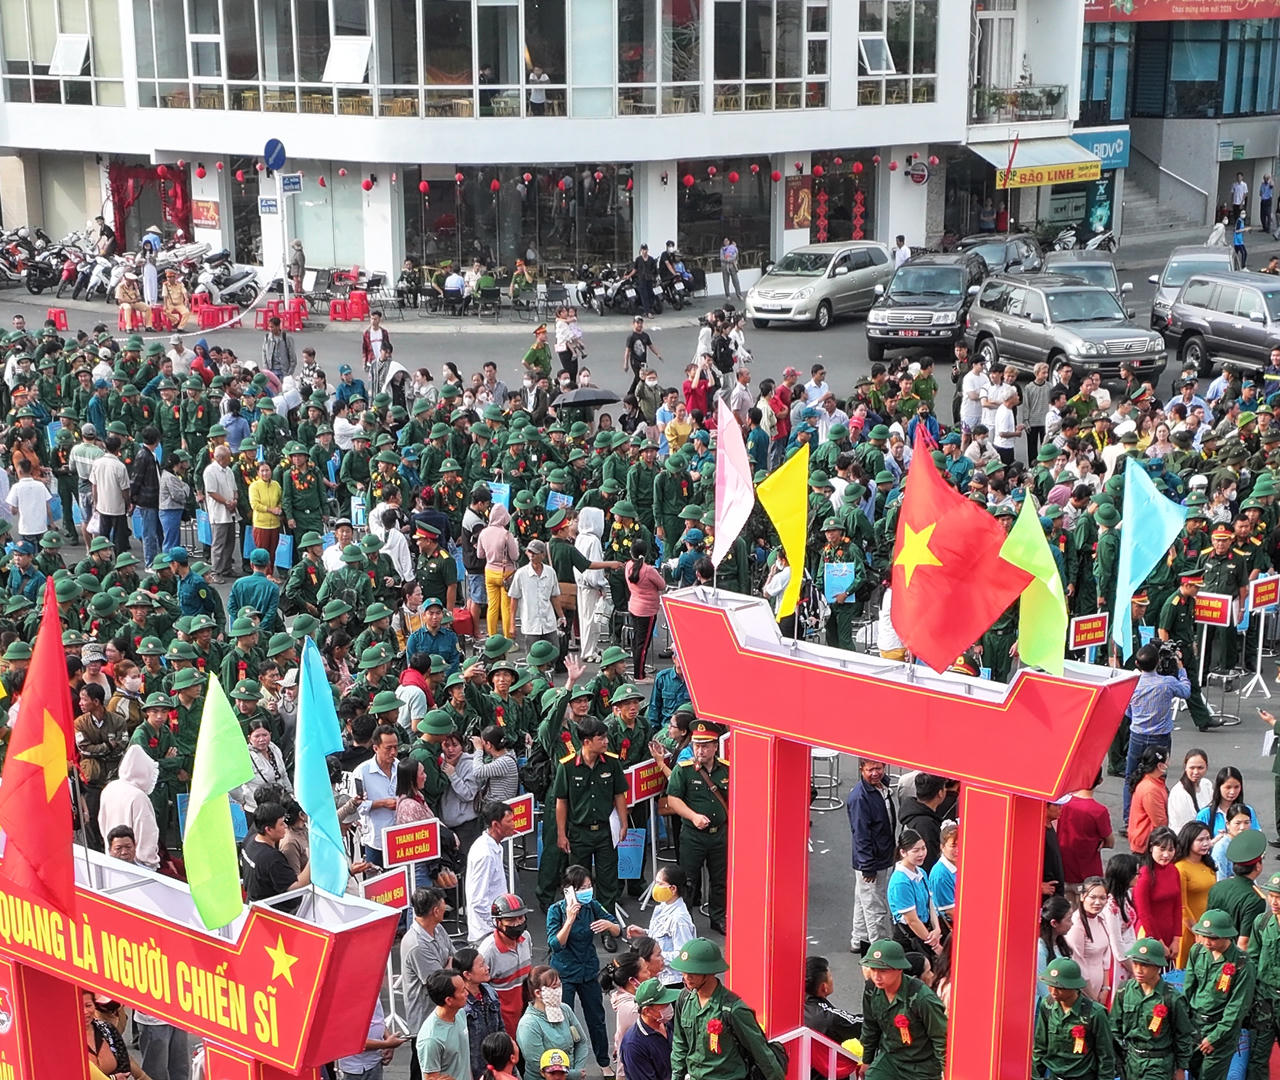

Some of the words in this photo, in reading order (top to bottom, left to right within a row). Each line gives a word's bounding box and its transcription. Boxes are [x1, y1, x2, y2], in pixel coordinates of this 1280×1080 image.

[1093, 142, 1115, 158] BIDV
[1047, 169, 1074, 182] LINH
[395, 832, 415, 845] THANH
[415, 829, 430, 843] NIÊN
[396, 849, 405, 859] XÃ
[405, 848, 414, 857] AN
[414, 844, 431, 856] CHÂU
[393, 886, 404, 899] 950
[69, 913, 99, 975] LÀ
[101, 930, 172, 1005] NGƯỜI
[175, 961, 248, 1035] CHIẾN
[254, 984, 279, 1049] SĨ
